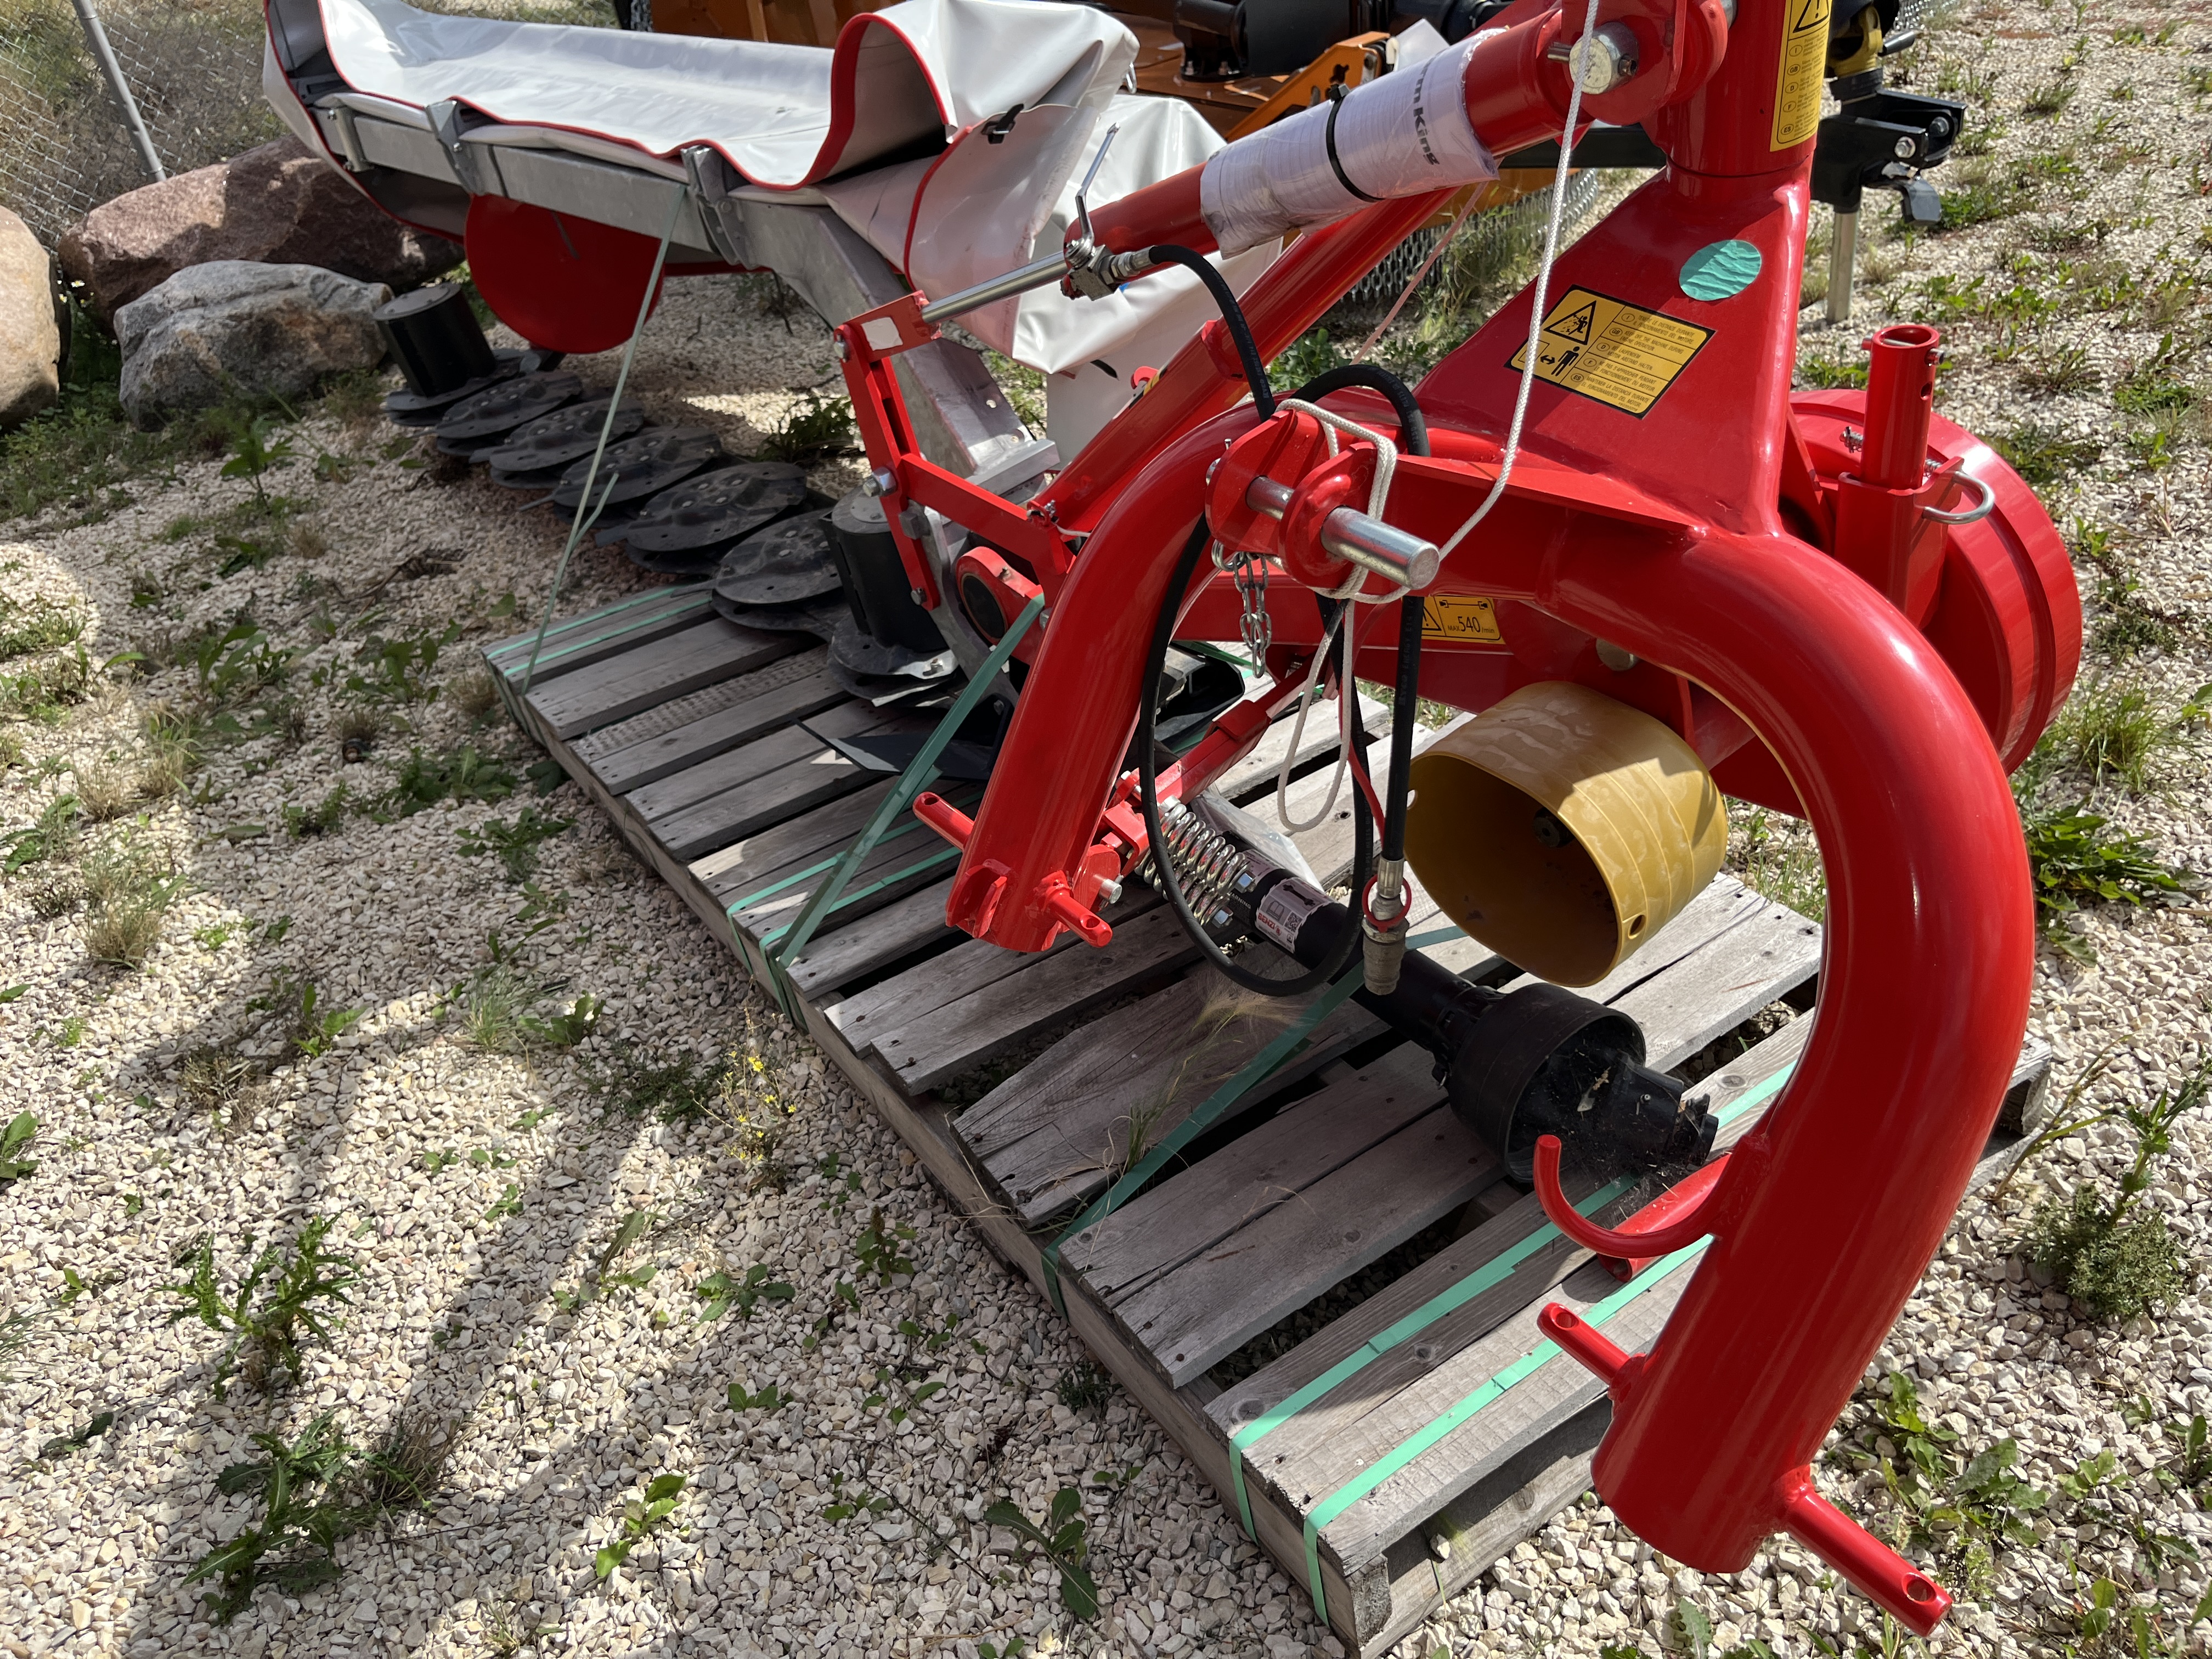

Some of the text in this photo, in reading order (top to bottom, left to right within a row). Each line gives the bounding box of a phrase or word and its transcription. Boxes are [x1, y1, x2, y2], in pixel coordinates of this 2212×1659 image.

[1413, 108, 1440, 165] King
[1657, 322, 1676, 331] DISTANZE
[1675, 328, 1695, 337] DURANTE
[1618, 348, 1640, 358] LAUFENDEM
[1650, 340, 1668, 348] MACHINE
[1668, 346, 1684, 354] DURING
[1621, 356, 1638, 365] ABSTAND
[1599, 368, 1632, 383] FONCTIONNEMENT
[1638, 375, 1656, 384] PENDANT
[1585, 376, 1606, 387] MANTENER
[1611, 386, 1631, 396] DISTANCIA
[1631, 393, 1649, 403] DURANTE
[1587, 383, 1618, 398] FUNCIONAMIENTO
[1458, 616, 1481, 633] 540
[1257, 912, 1276, 930] BENZI
